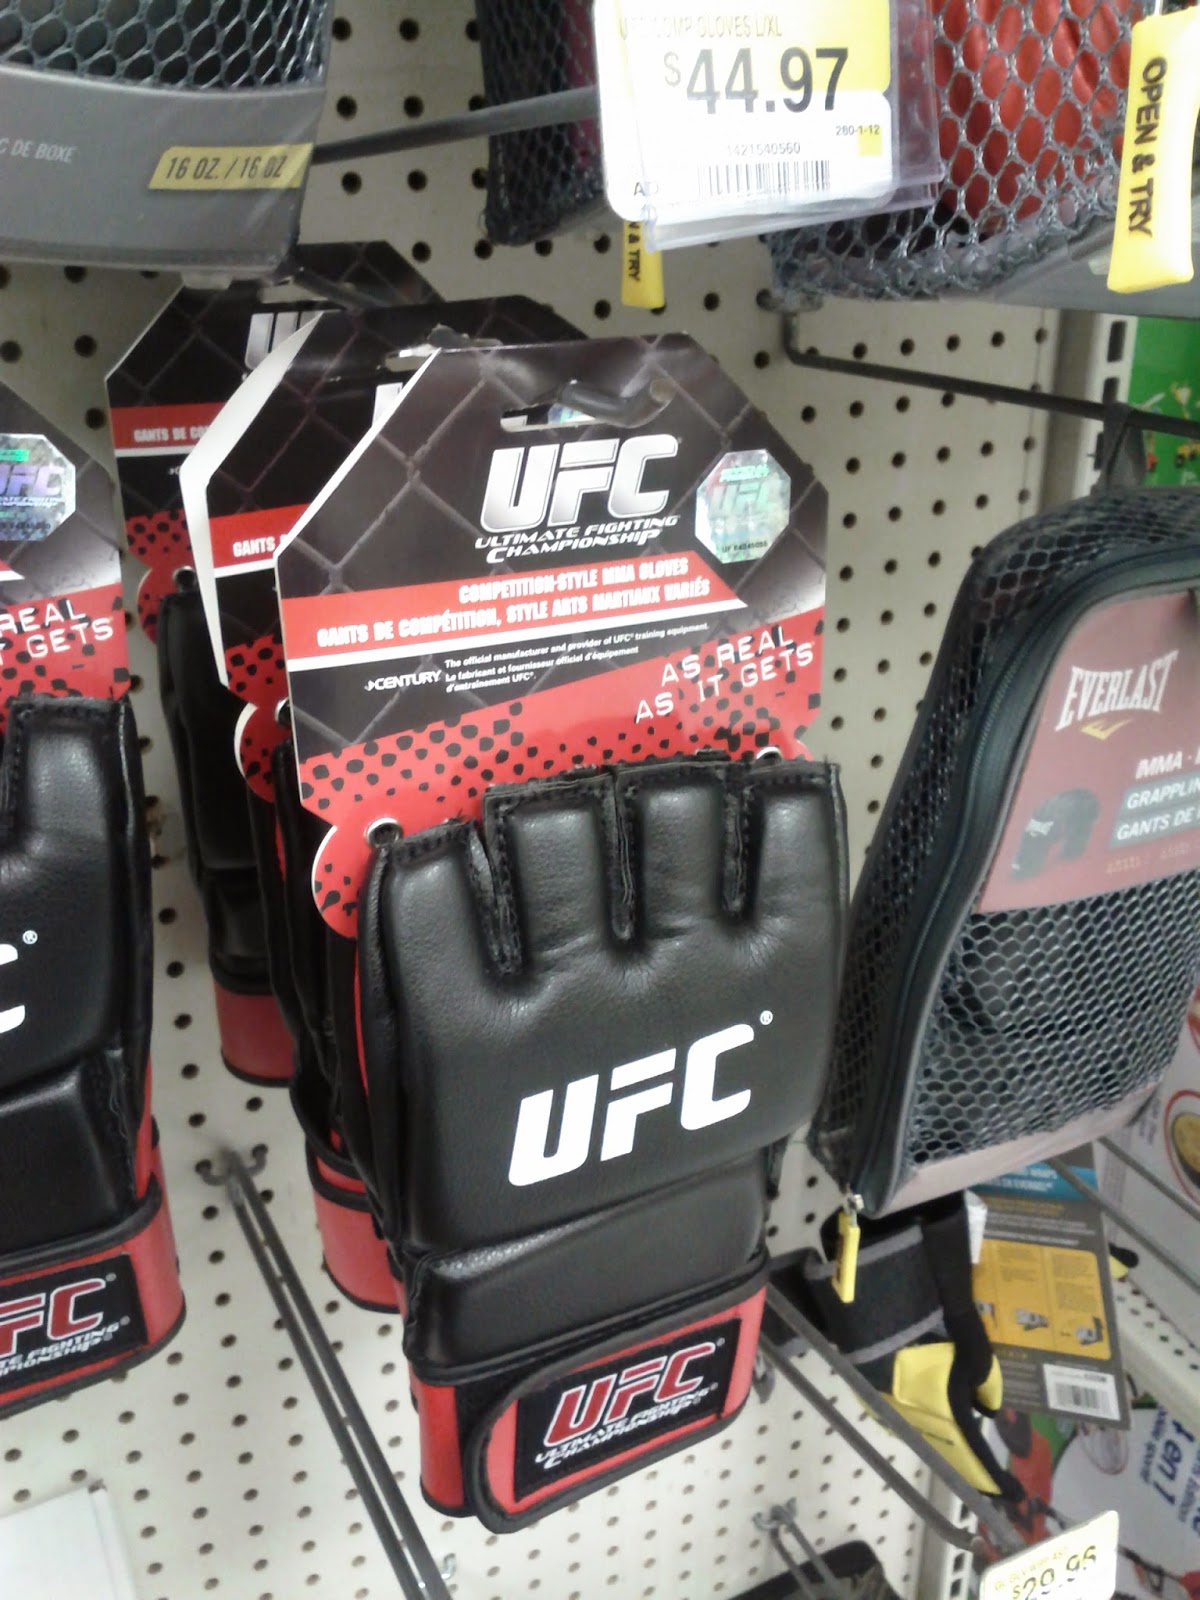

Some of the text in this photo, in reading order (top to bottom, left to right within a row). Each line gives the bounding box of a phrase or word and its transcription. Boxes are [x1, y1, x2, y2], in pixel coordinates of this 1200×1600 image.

[663, 46, 848, 114] $44.97
[10, 139, 33, 157] DE
[35, 143, 77, 163] BOXE
[165, 156, 189, 180] 16
[239, 155, 260, 179] 16
[1128, 57, 1167, 238] OPEN & TRY
[134, 428, 168, 442] GANTS
[480, 433, 678, 533] UFC
[233, 537, 275, 557] GANTS
[475, 515, 681, 549] ULTIMATE FIGHTING
[486, 529, 662, 563] CHAMPIONSHIP
[459, 557, 689, 604] COMPETITION-STYLE MMA GLOVES
[317, 624, 369, 647] GANTS
[373, 621, 394, 641] DE
[506, 602, 548, 623] STYLE
[552, 596, 588, 617] ARTS
[592, 585, 661, 611] MARTIAUX
[664, 576, 710, 601] VARIÉS
[27, 617, 113, 658] GETS
[444, 659, 461, 668] The
[463, 654, 492, 666] official
[493, 647, 549, 661] manufacturer
[550, 643, 566, 653] and
[568, 639, 601, 652] provider
[603, 636, 612, 645] of
[635, 629, 665, 640] training
[662, 626, 793, 686] AS REAL
[375, 670, 442, 690] CENTURY
[445, 674, 456, 682] Le
[458, 668, 496, 680] fabricant
[497, 666, 506, 674] et
[508, 660, 554, 673] fournisseur
[556, 653, 583, 665] officiel
[635, 643, 814, 724] AS IT GETS
[1055, 649, 1180, 731] EVERLAST
[1135, 750, 1183, 779] MMA
[1117, 806, 1195, 840] GANTS DE
[508, 1023, 754, 1187] UFC
[0, 1278, 106, 1360] FC
[543, 1341, 716, 1447] UFC
